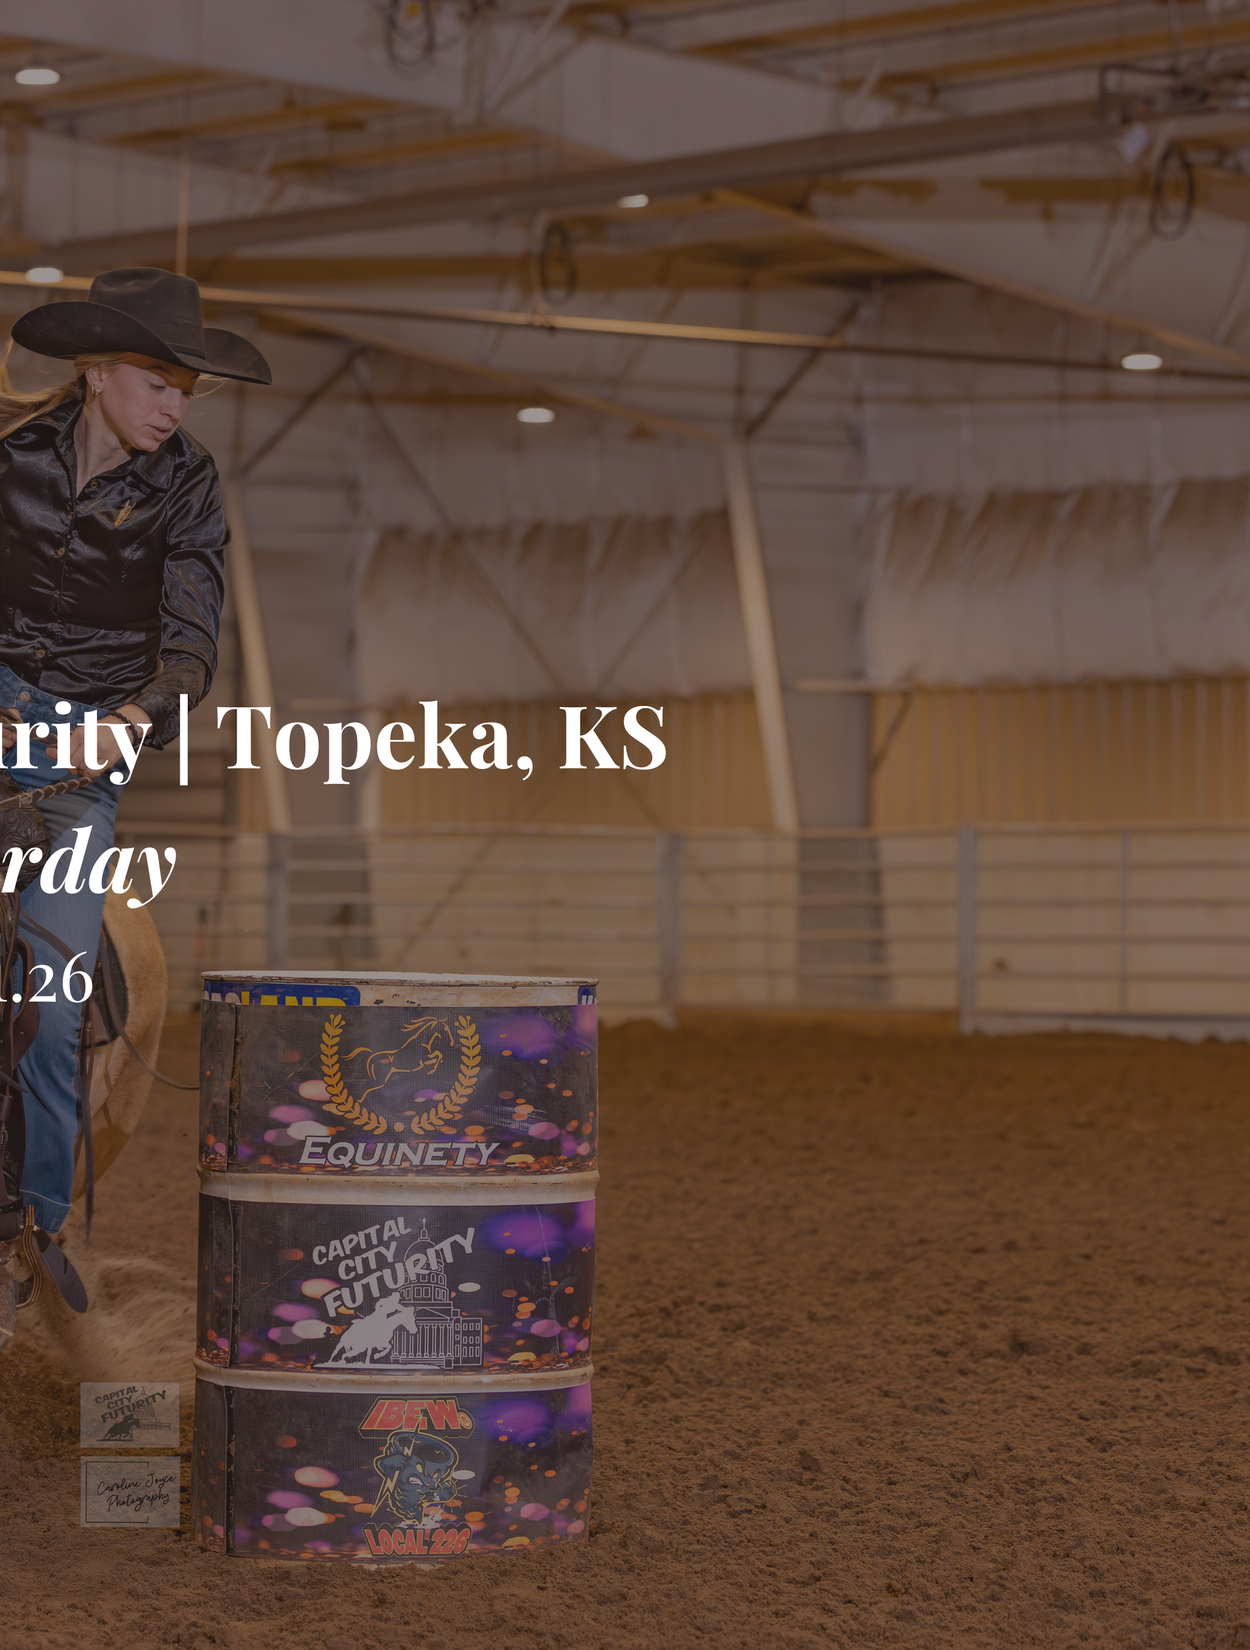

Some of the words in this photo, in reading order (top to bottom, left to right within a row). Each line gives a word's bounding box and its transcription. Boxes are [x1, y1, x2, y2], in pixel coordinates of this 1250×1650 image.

[298, 1136, 500, 1168] EQUINETY
[312, 1217, 412, 1265] CAPITAL
[323, 1227, 475, 1317] FUTURITY
[338, 1242, 397, 1280] CITY
[363, 1529, 428, 1555] LOCAL
[428, 1528, 471, 1555] 226
